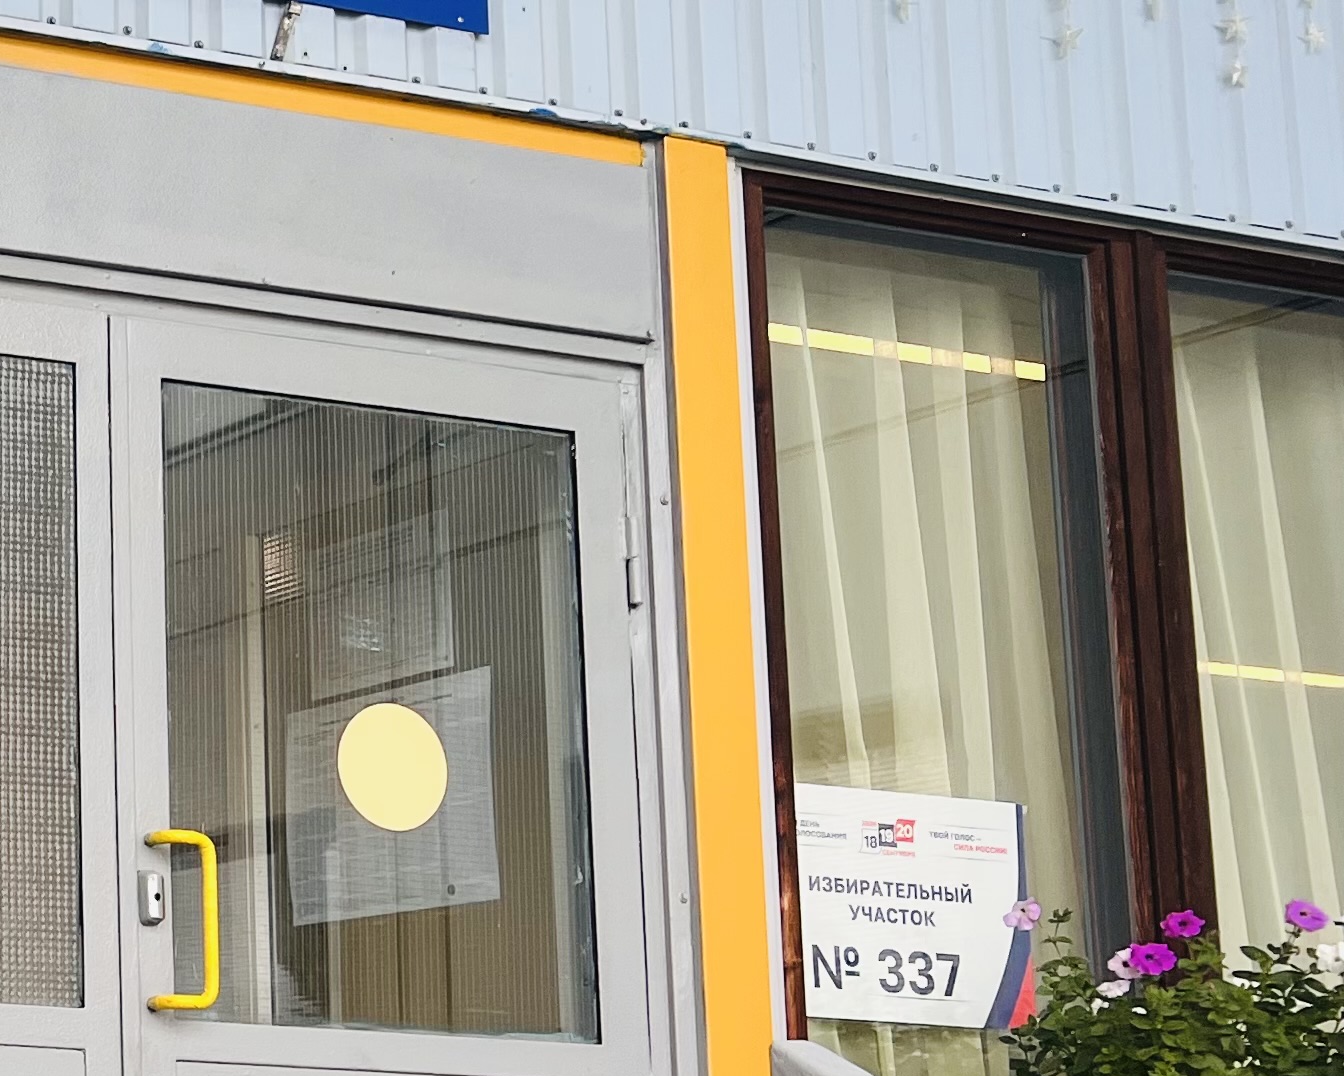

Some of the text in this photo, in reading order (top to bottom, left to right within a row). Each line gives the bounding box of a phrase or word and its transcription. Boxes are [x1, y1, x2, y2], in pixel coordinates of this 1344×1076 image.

[796, 828, 848, 841] ОЛОСОВАНИЯ
[879, 828, 895, 844] 19
[896, 823, 914, 839] 20
[928, 828, 949, 840] ТВОЙ
[950, 832, 976, 843] ГОЛОС
[864, 835, 878, 849] 18
[808, 874, 973, 904] ИЗБИРАТЕЛЬНЫЙ
[848, 904, 937, 928] УЧАСТОК
[812, 944, 961, 997] № 337
